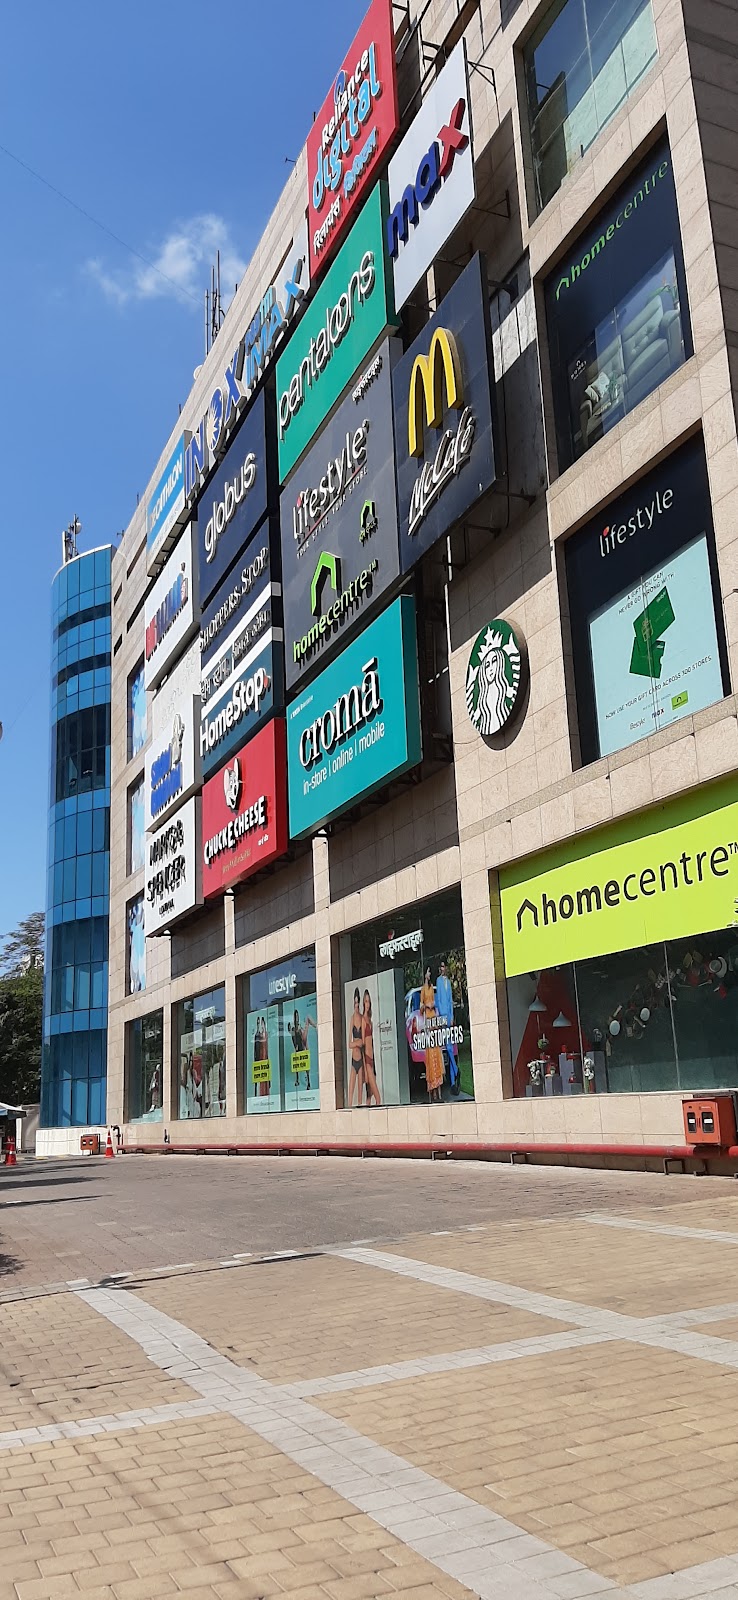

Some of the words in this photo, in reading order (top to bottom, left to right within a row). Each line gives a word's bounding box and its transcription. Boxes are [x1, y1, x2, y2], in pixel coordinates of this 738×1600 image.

[313, 41, 381, 210] digital
[322, 49, 368, 148] Reliance
[388, 97, 469, 258] max
[570, 161, 669, 283] homecentre
[245, 258, 304, 390] IMAX
[279, 250, 376, 439] pantaloons
[204, 452, 257, 564] globus
[293, 422, 369, 540] lifestyle
[598, 487, 674, 558] lifestyle
[302, 764, 328, 796] in-store
[332, 746, 355, 776] online
[358, 721, 385, 755] mobile
[203, 826, 227, 865] CHUCK
[234, 795, 266, 838] CHEESE
[379, 927, 424, 959] लाइफस्टाइल
[412, 1025, 464, 1051] SHOWSTOPPERS
